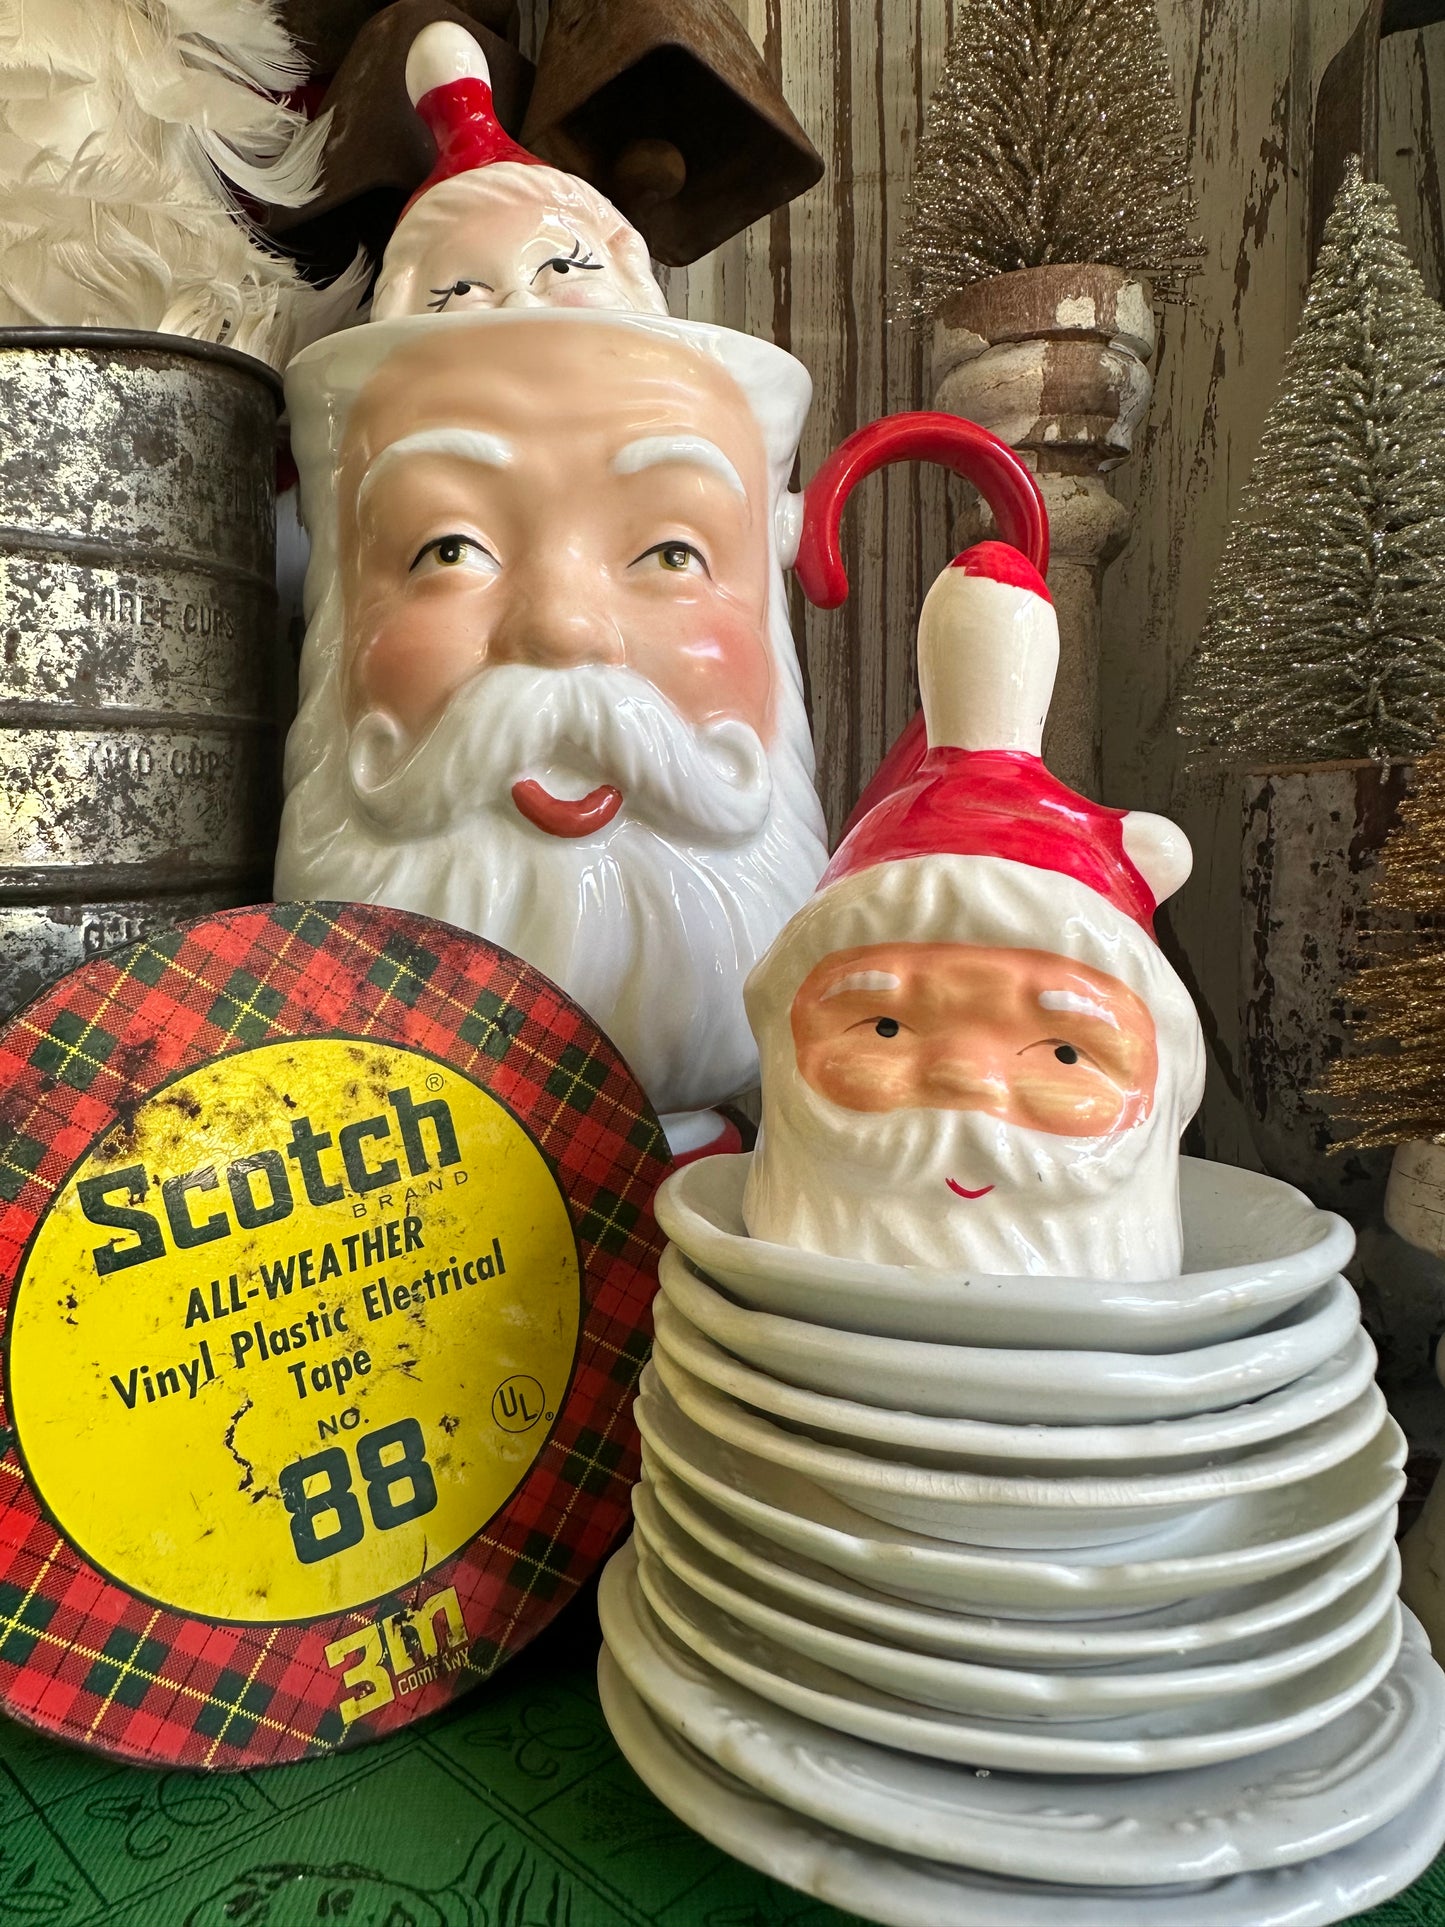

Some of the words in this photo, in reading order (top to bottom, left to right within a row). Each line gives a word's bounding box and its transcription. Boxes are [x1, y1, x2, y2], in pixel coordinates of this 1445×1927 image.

[183, 603, 236, 640] CUPS
[76, 1087, 462, 1276] Scotch
[352, 1170, 469, 1219] BRAND
[184, 1215, 425, 1329] ALL-WEATHER
[110, 1341, 217, 1410] Vinyl
[231, 1301, 349, 1370] Plastic
[362, 1238, 507, 1322] Electrical
[287, 1350, 373, 1400] Tape
[317, 1406, 370, 1441] NO.
[497, 1383, 541, 1424] UL
[278, 1417, 438, 1565] 88
